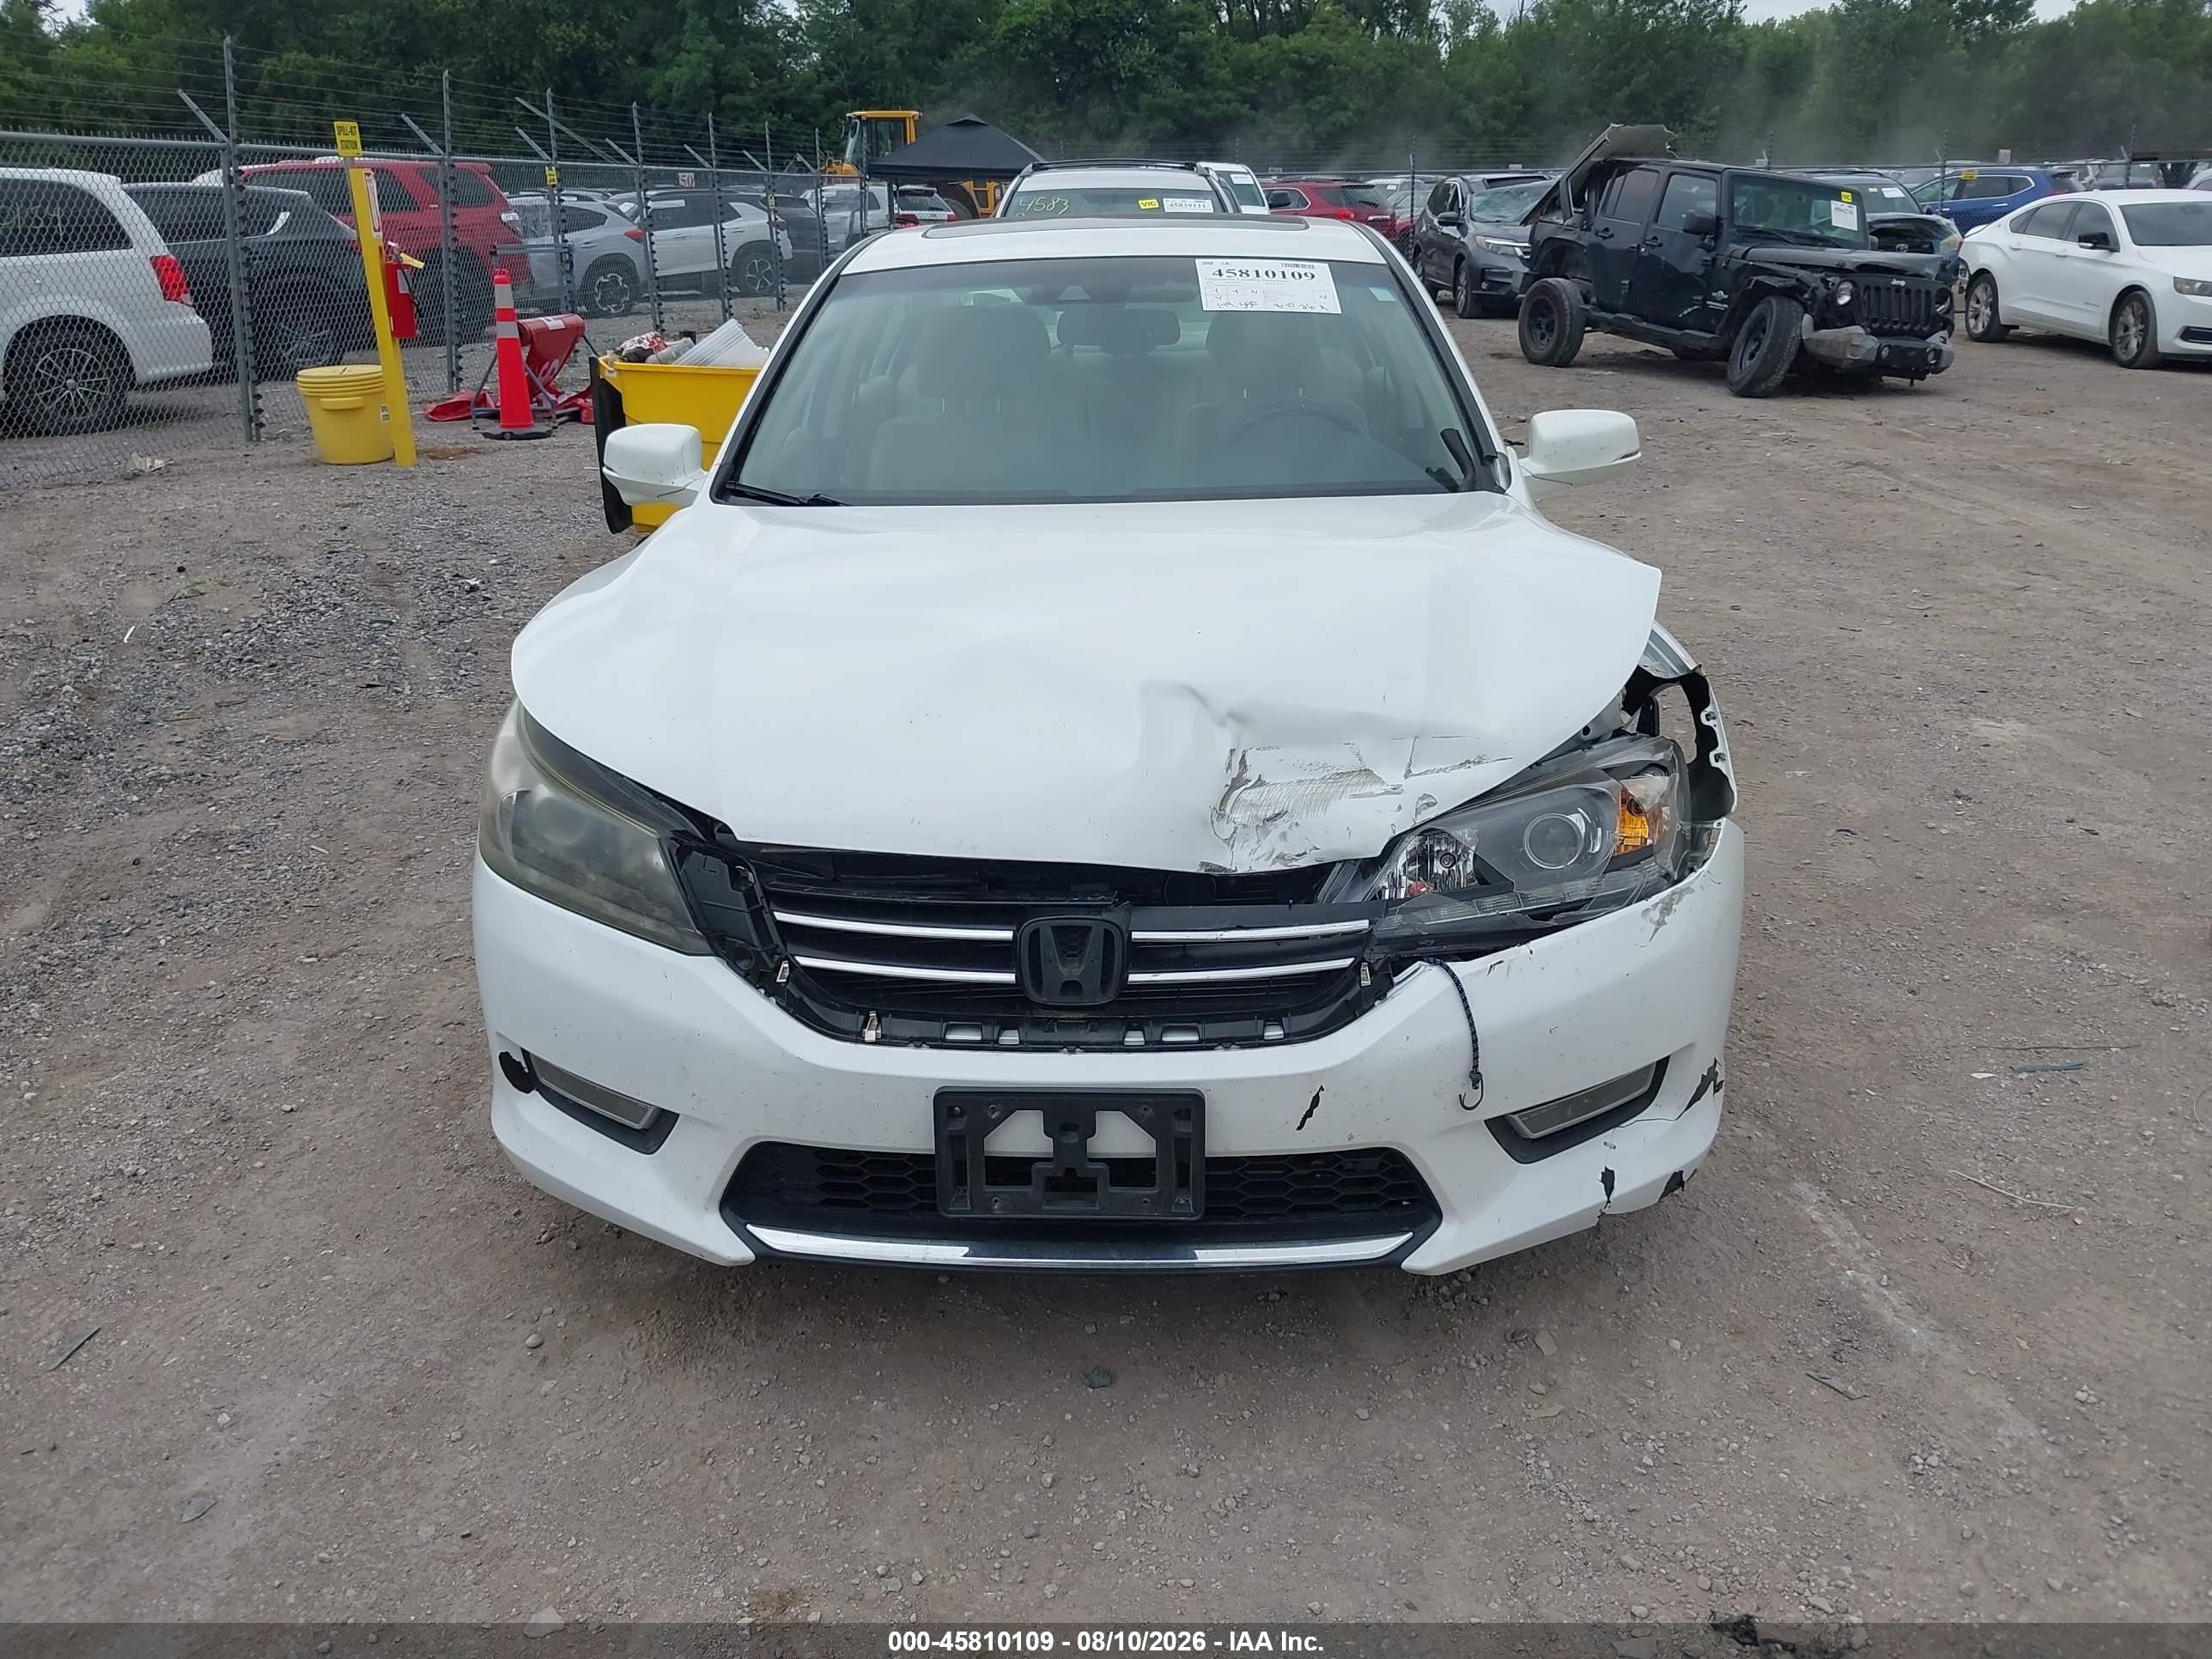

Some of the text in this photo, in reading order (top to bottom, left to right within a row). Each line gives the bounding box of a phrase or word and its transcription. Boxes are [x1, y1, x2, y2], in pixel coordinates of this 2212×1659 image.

[1019, 197, 1069, 215] 4583
[1212, 268, 1316, 281] 45810109
[1891, 278, 1905, 287] Jeep
